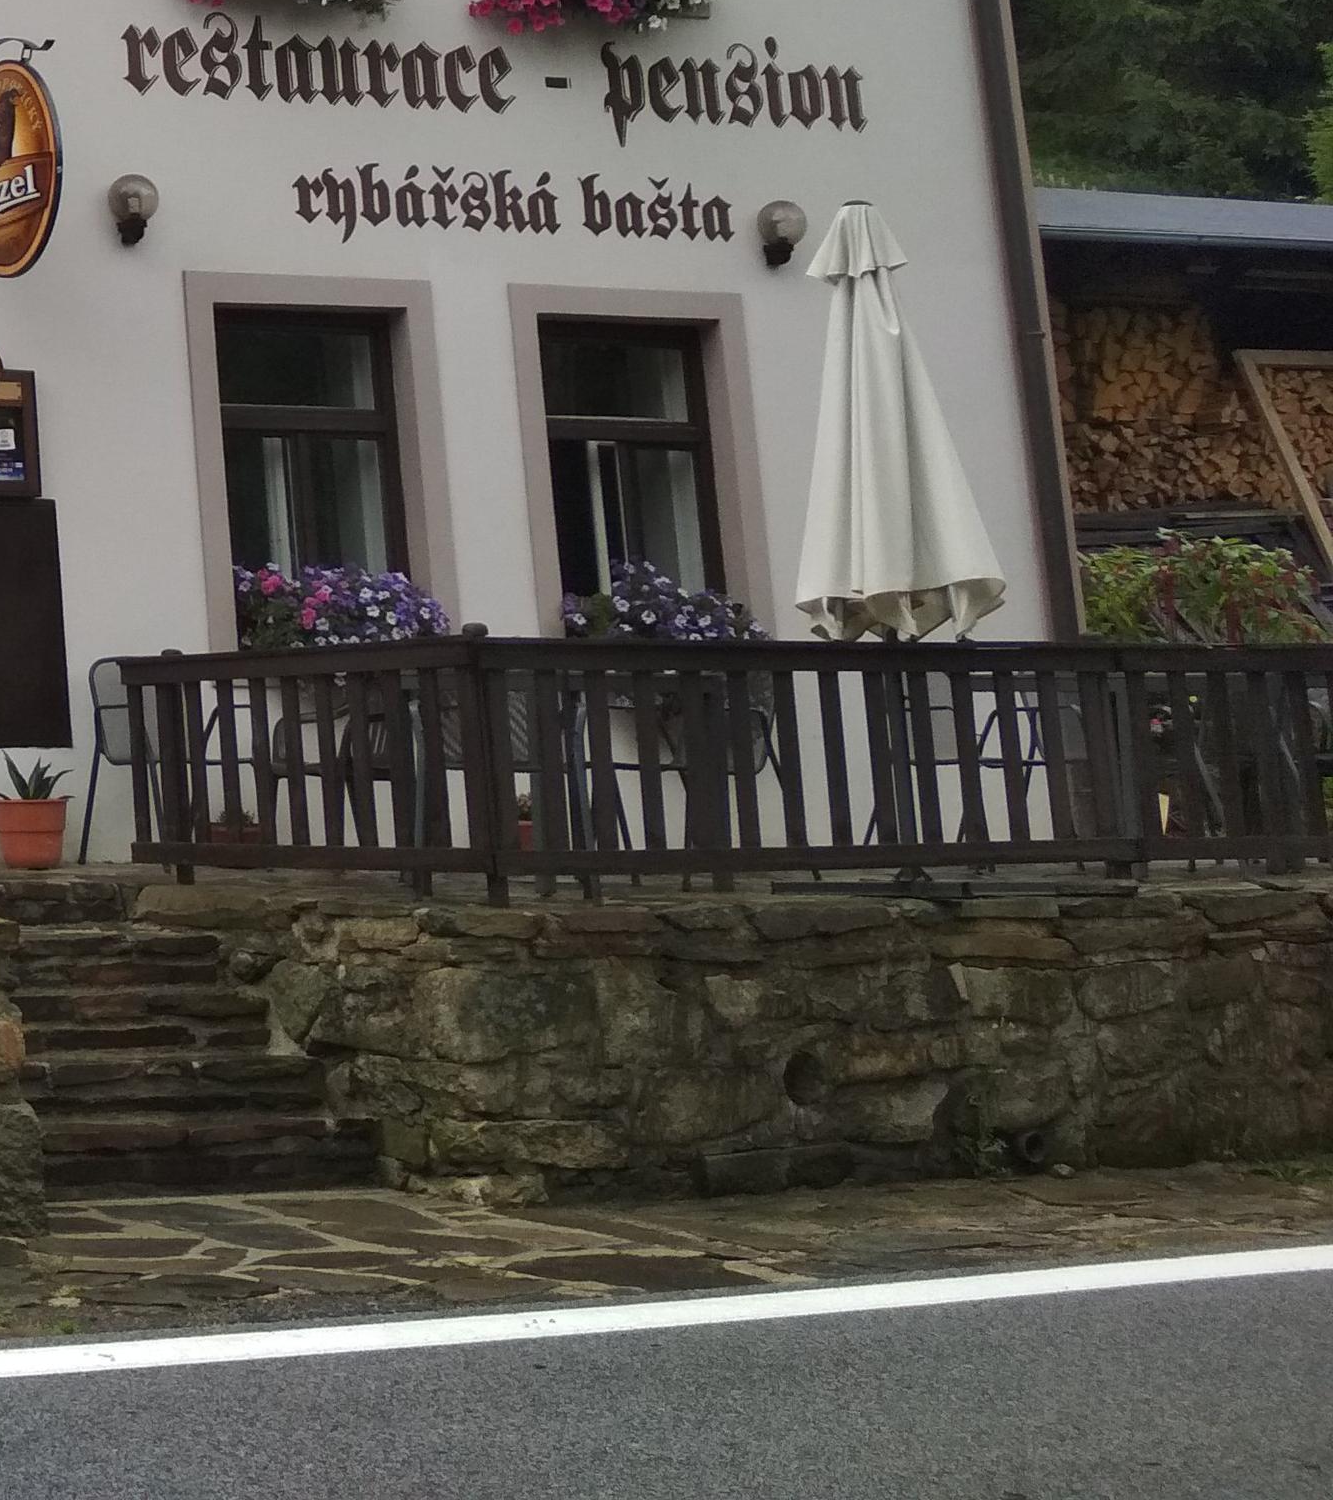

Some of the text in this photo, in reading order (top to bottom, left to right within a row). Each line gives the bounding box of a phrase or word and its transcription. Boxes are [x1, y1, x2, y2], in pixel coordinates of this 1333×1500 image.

[120, 11, 517, 114] restaurace
[600, 36, 869, 148] pension
[292, 162, 735, 244] rybářská bašta
